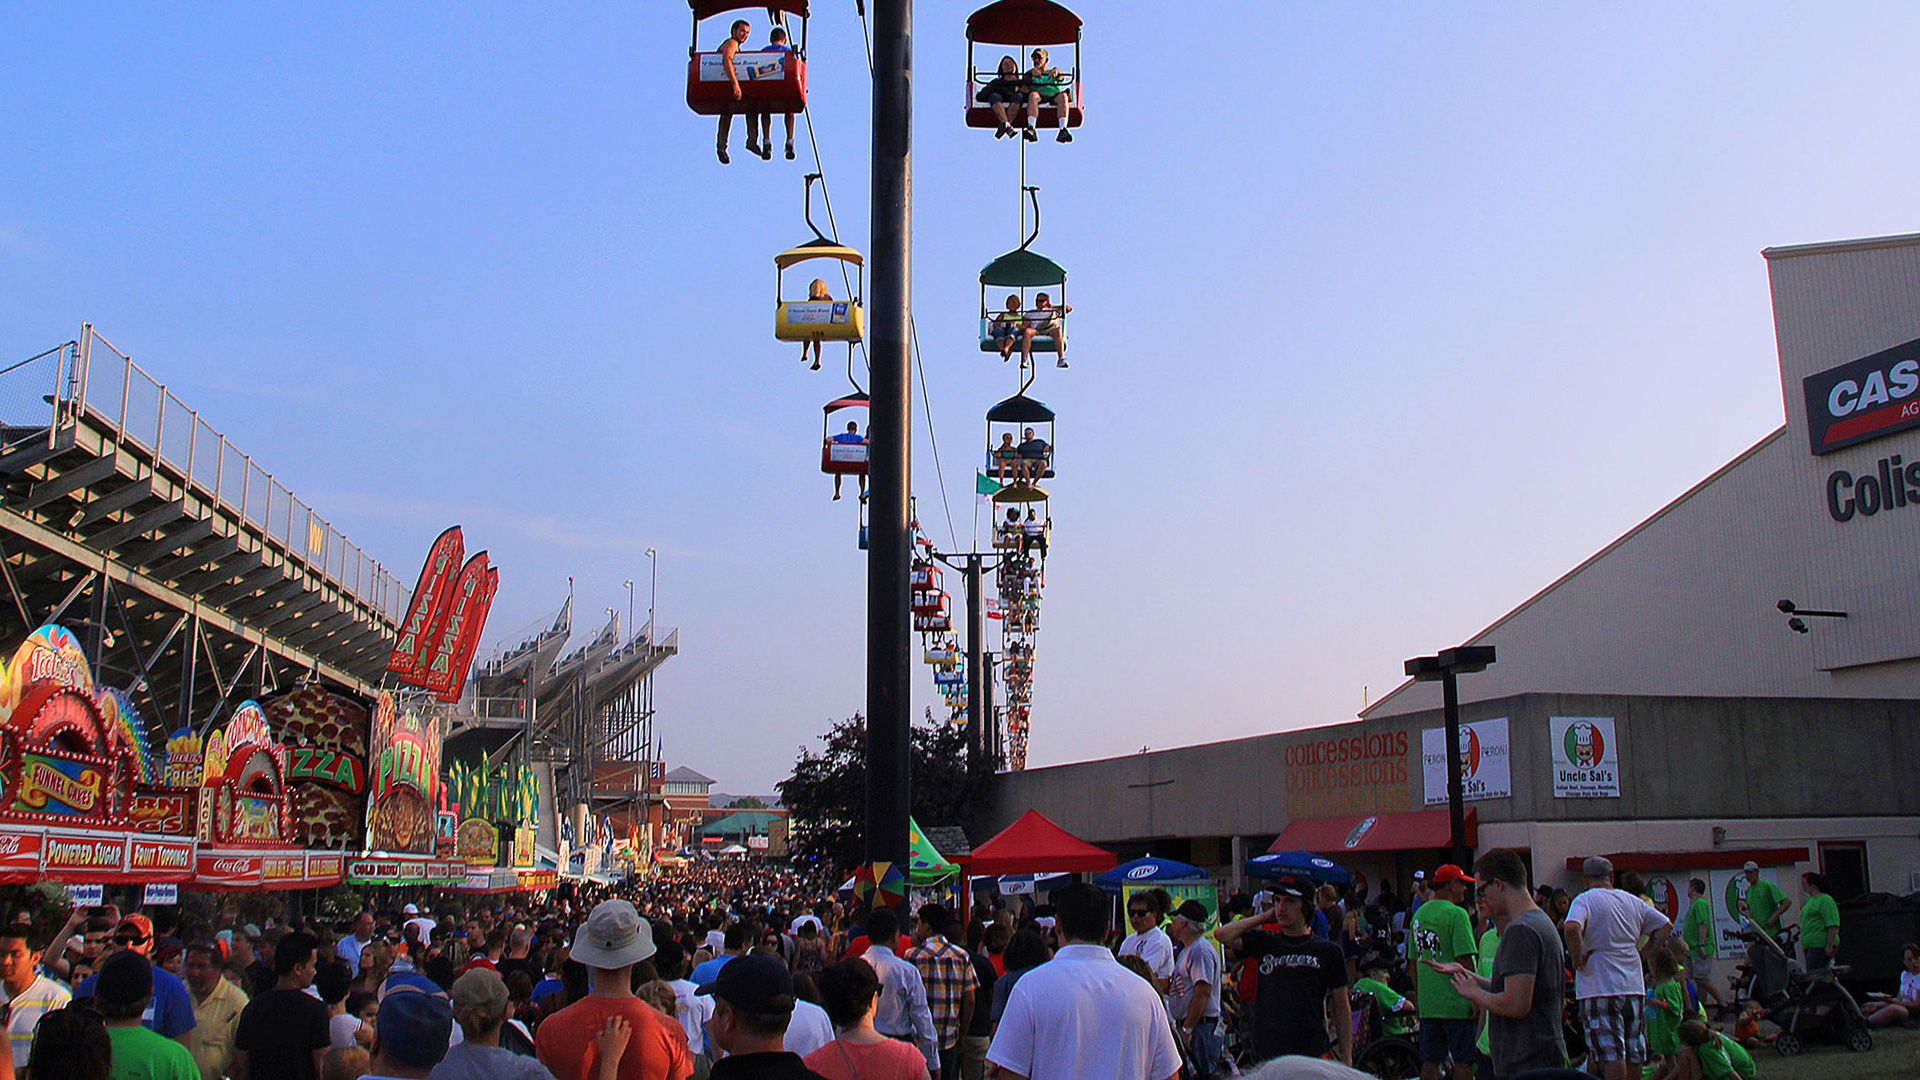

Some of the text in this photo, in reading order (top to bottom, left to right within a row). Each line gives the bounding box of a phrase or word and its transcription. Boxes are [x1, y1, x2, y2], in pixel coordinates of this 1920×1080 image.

[1285, 729, 1408, 767] concessions
[1481, 745, 1508, 758] PERONI
[32, 764, 92, 807] FUNNEL CAKES
[163, 765, 204, 787] FRIES
[1285, 758, 1409, 791] concessions
[1560, 770, 1612, 782] Uncle Sal's
[1468, 780, 1486, 793] Sal's
[201, 789, 211, 841] JACKS
[93, 842, 121, 866] SUGAR
[133, 843, 189, 867] FRUIT TOPPINGS
[354, 863, 375, 875] COLD
[1260, 953, 1320, 975] Brewers
